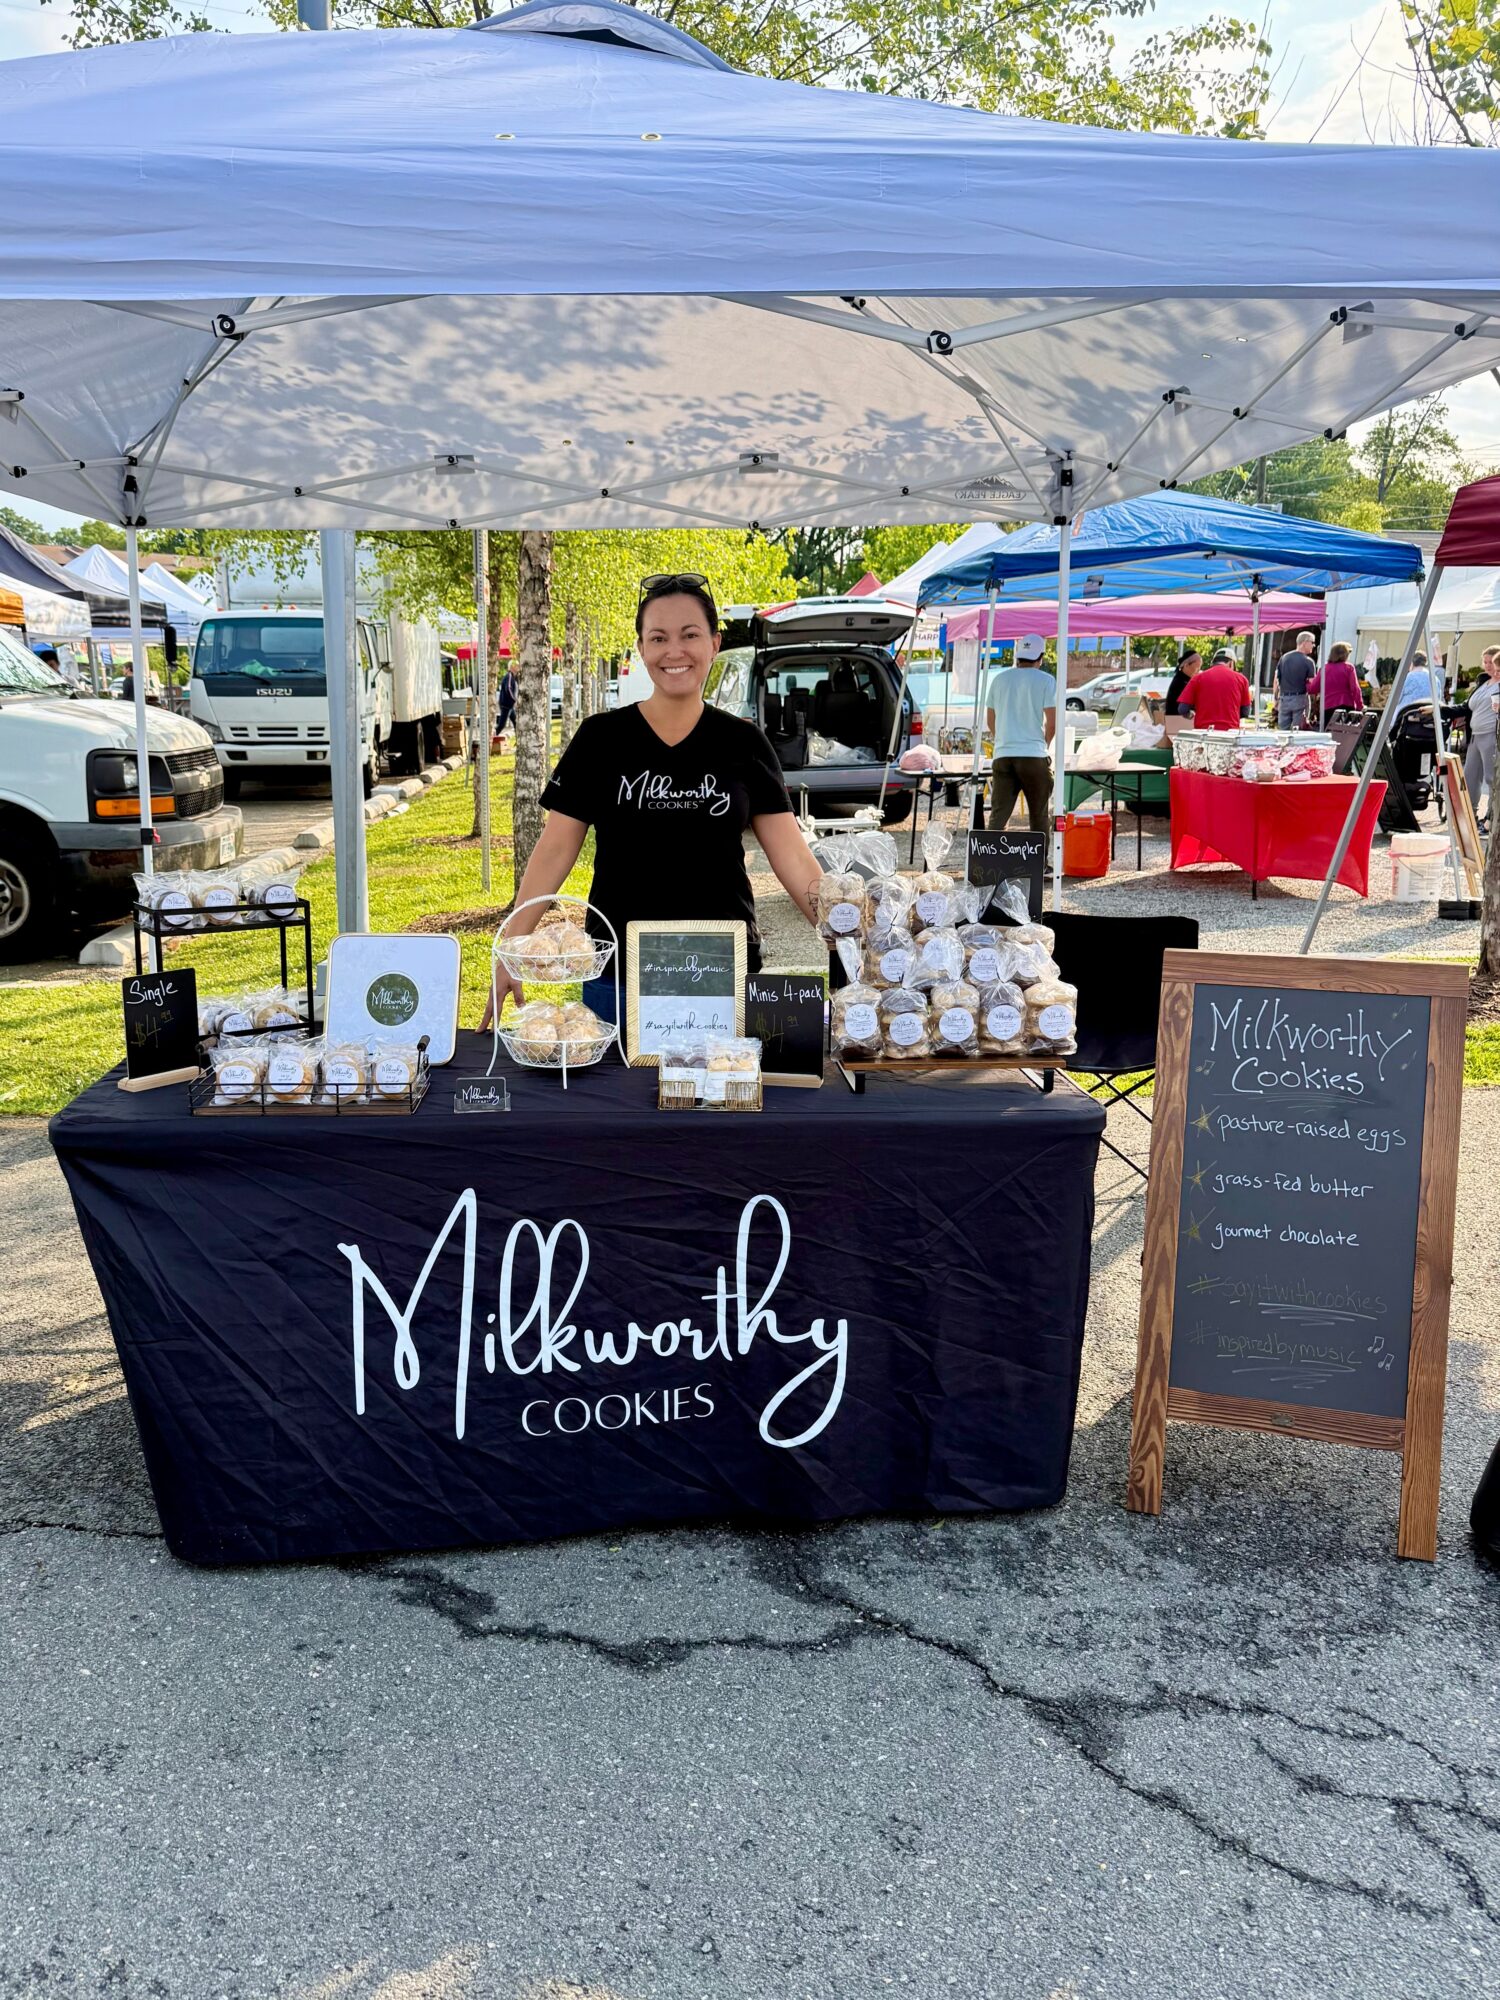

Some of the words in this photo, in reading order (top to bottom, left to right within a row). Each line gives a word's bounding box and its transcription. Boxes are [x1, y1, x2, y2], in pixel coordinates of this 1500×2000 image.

[256, 688, 292, 696] ISUZU
[617, 769, 730, 816] Milkworthy
[970, 837, 998, 856] Minis
[999, 835, 1042, 860] Sampler
[644, 954, 730, 982] #inspiredbymusic
[126, 979, 178, 1007] Single
[748, 981, 779, 1002] Minis
[783, 979, 823, 1004] 4-pack
[645, 1011, 728, 1036] #sayitwithcookies
[1211, 998, 1413, 1081] Milkworthy
[1231, 1057, 1365, 1095] Cookies
[1217, 1114, 1350, 1142] pasture-raised
[1357, 1129, 1406, 1152] eggs
[1213, 1173, 1301, 1193] grass-fed
[1310, 1174, 1374, 1198] butter
[1211, 1222, 1272, 1249] gourmet
[1279, 1224, 1360, 1247] chocolate
[337, 1187, 848, 1448] Milkworthy
[521, 1383, 715, 1437] COOKIES
